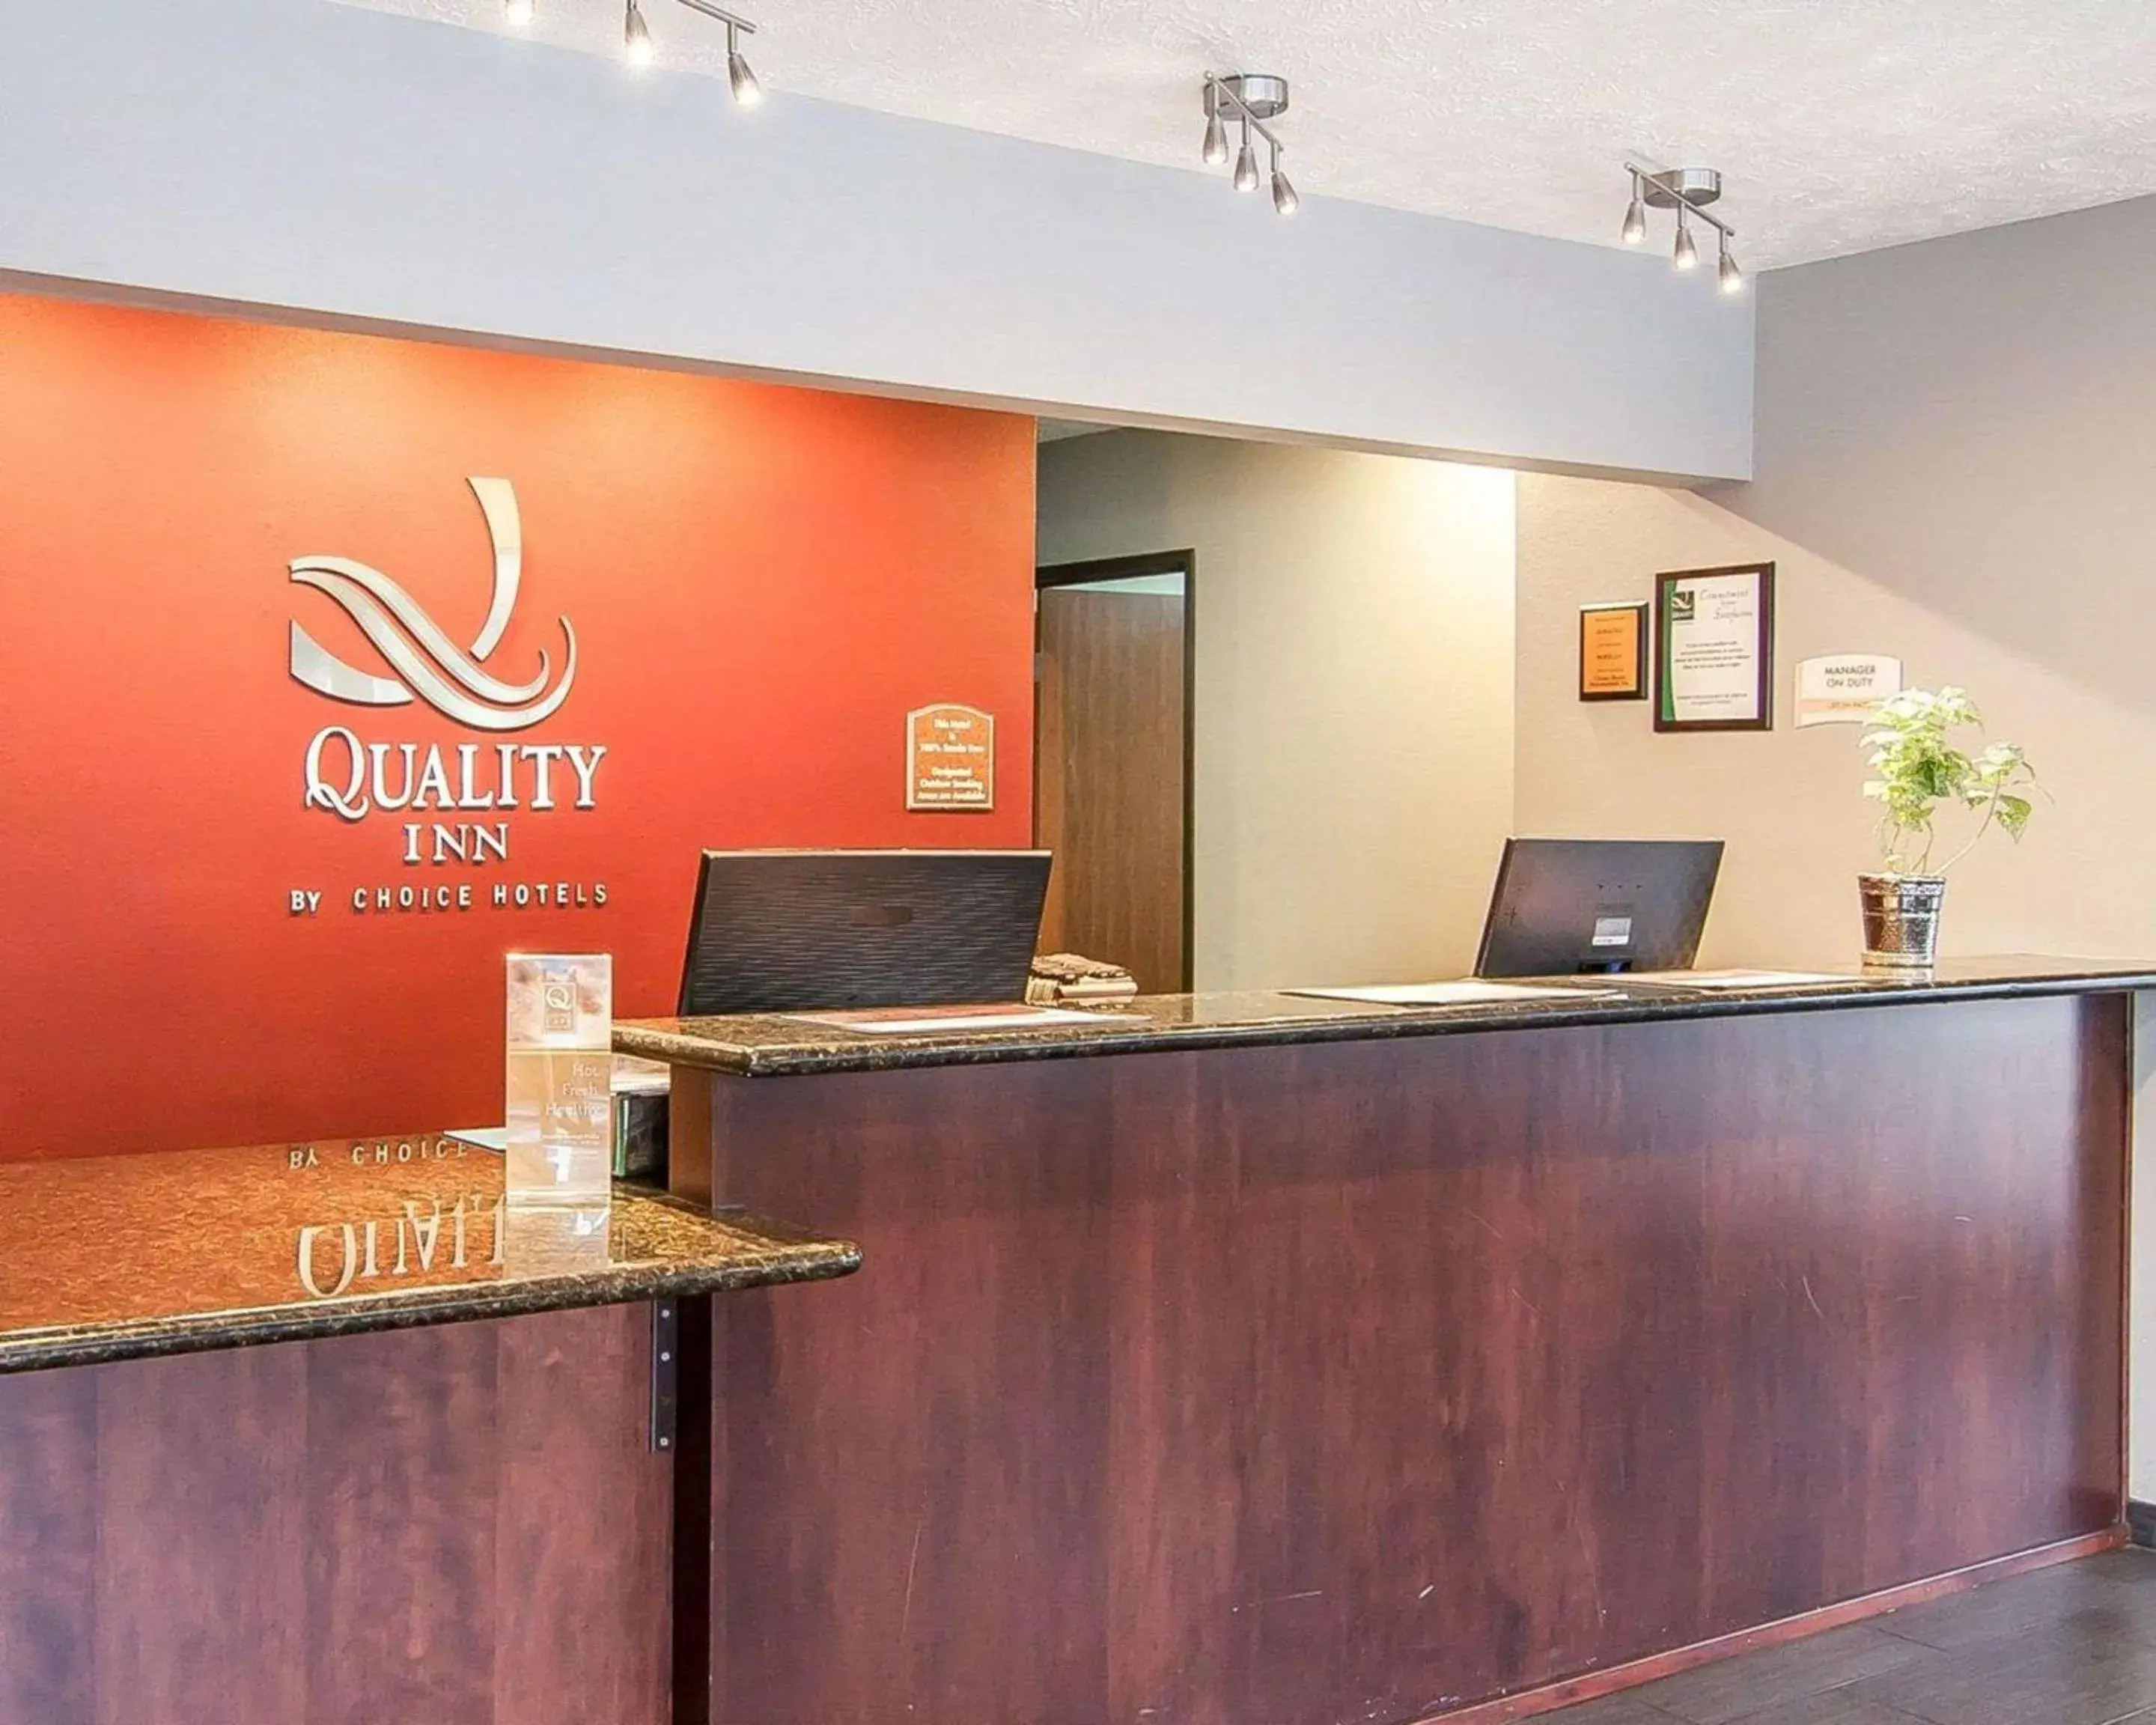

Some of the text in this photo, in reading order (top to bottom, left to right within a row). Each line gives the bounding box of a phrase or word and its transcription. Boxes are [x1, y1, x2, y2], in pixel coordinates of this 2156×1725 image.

[1824, 664, 1875, 675] MANAGER
[1826, 677, 1873, 688] ON DUTY
[304, 725, 608, 820] QUALITY
[402, 823, 510, 864] INN
[290, 882, 609, 913] BY CHOICE HOTELS
